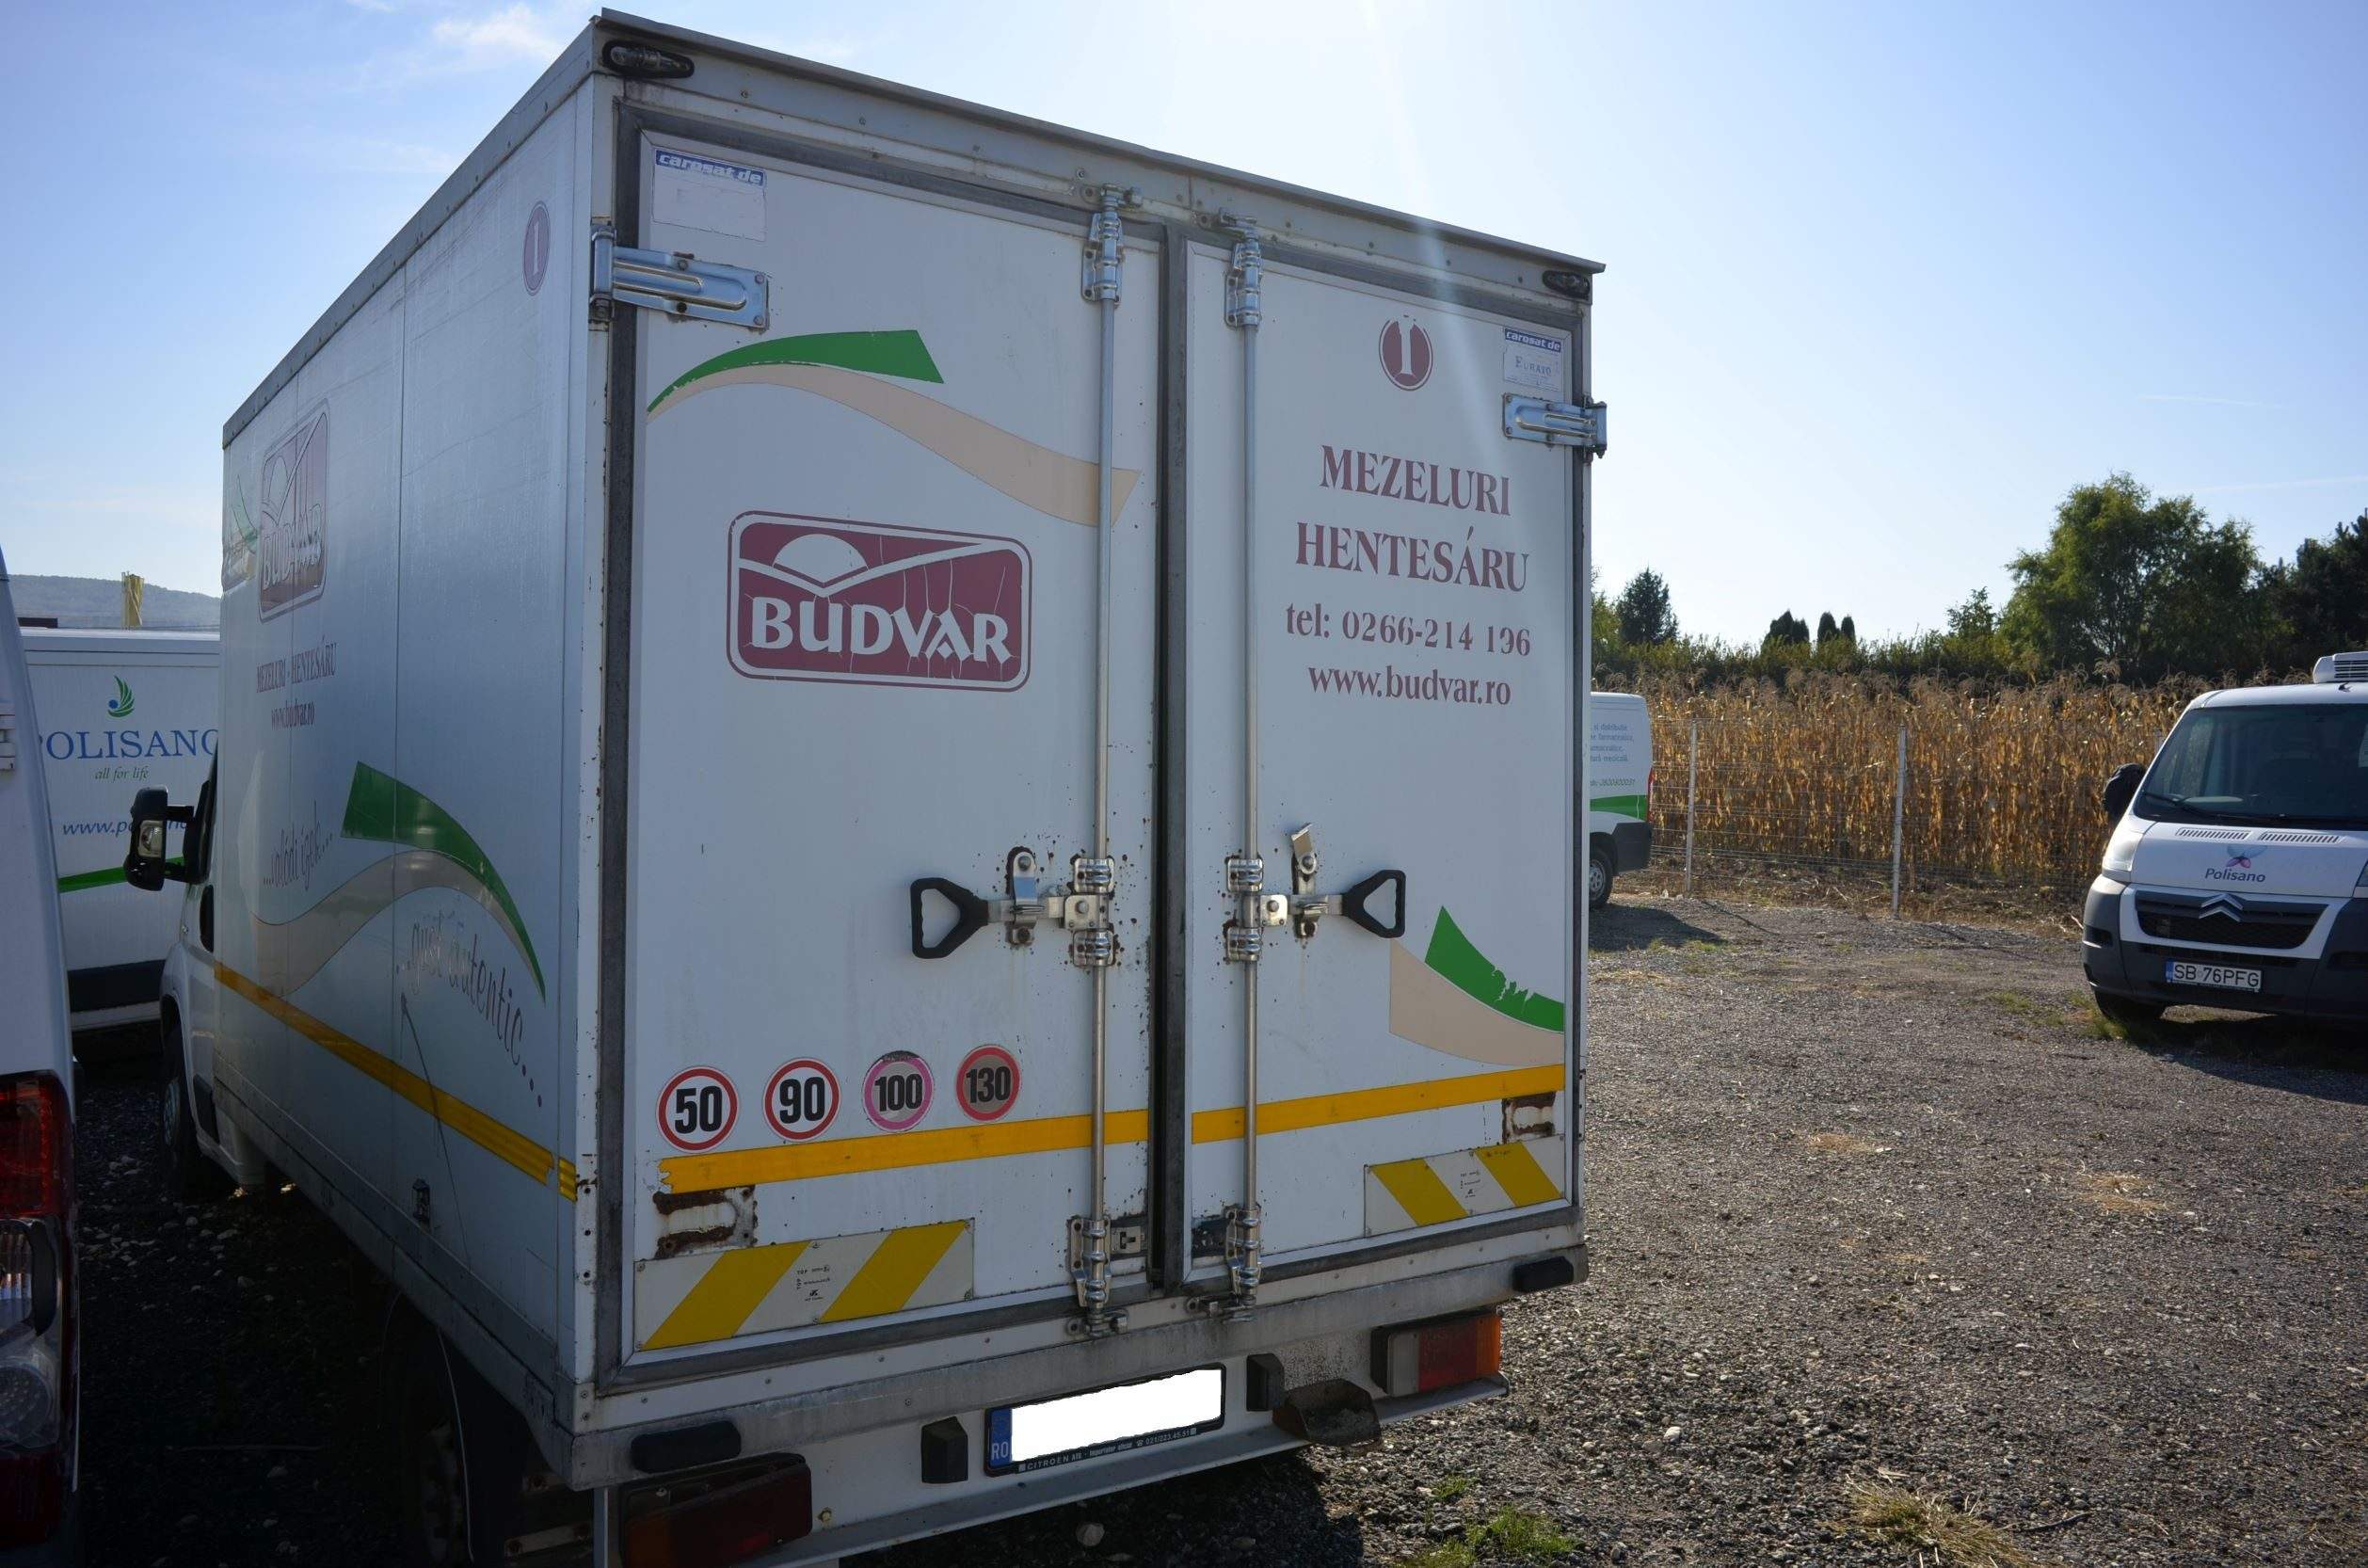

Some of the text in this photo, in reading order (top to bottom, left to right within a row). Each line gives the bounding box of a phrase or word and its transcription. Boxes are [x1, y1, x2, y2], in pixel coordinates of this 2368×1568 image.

[529, 221, 542, 277] 1
[1320, 444, 1511, 516] MEZELURI
[1295, 521, 1529, 592] HENTESÁRU
[750, 596, 1012, 664] BUDVAR
[1286, 602, 1330, 638] tel:
[1308, 664, 1512, 705] www.budvar.ro
[39, 728, 218, 760] OLISANO
[95, 765, 150, 782] all for life
[2204, 868, 2265, 883] Polisano
[2173, 963, 2197, 981] SB
[778, 1076, 824, 1125] 90
[874, 1074, 923, 1112] 100
[966, 1065, 1011, 1103] 130
[674, 1085, 723, 1135] 50
[992, 1442, 1009, 1460] RO
